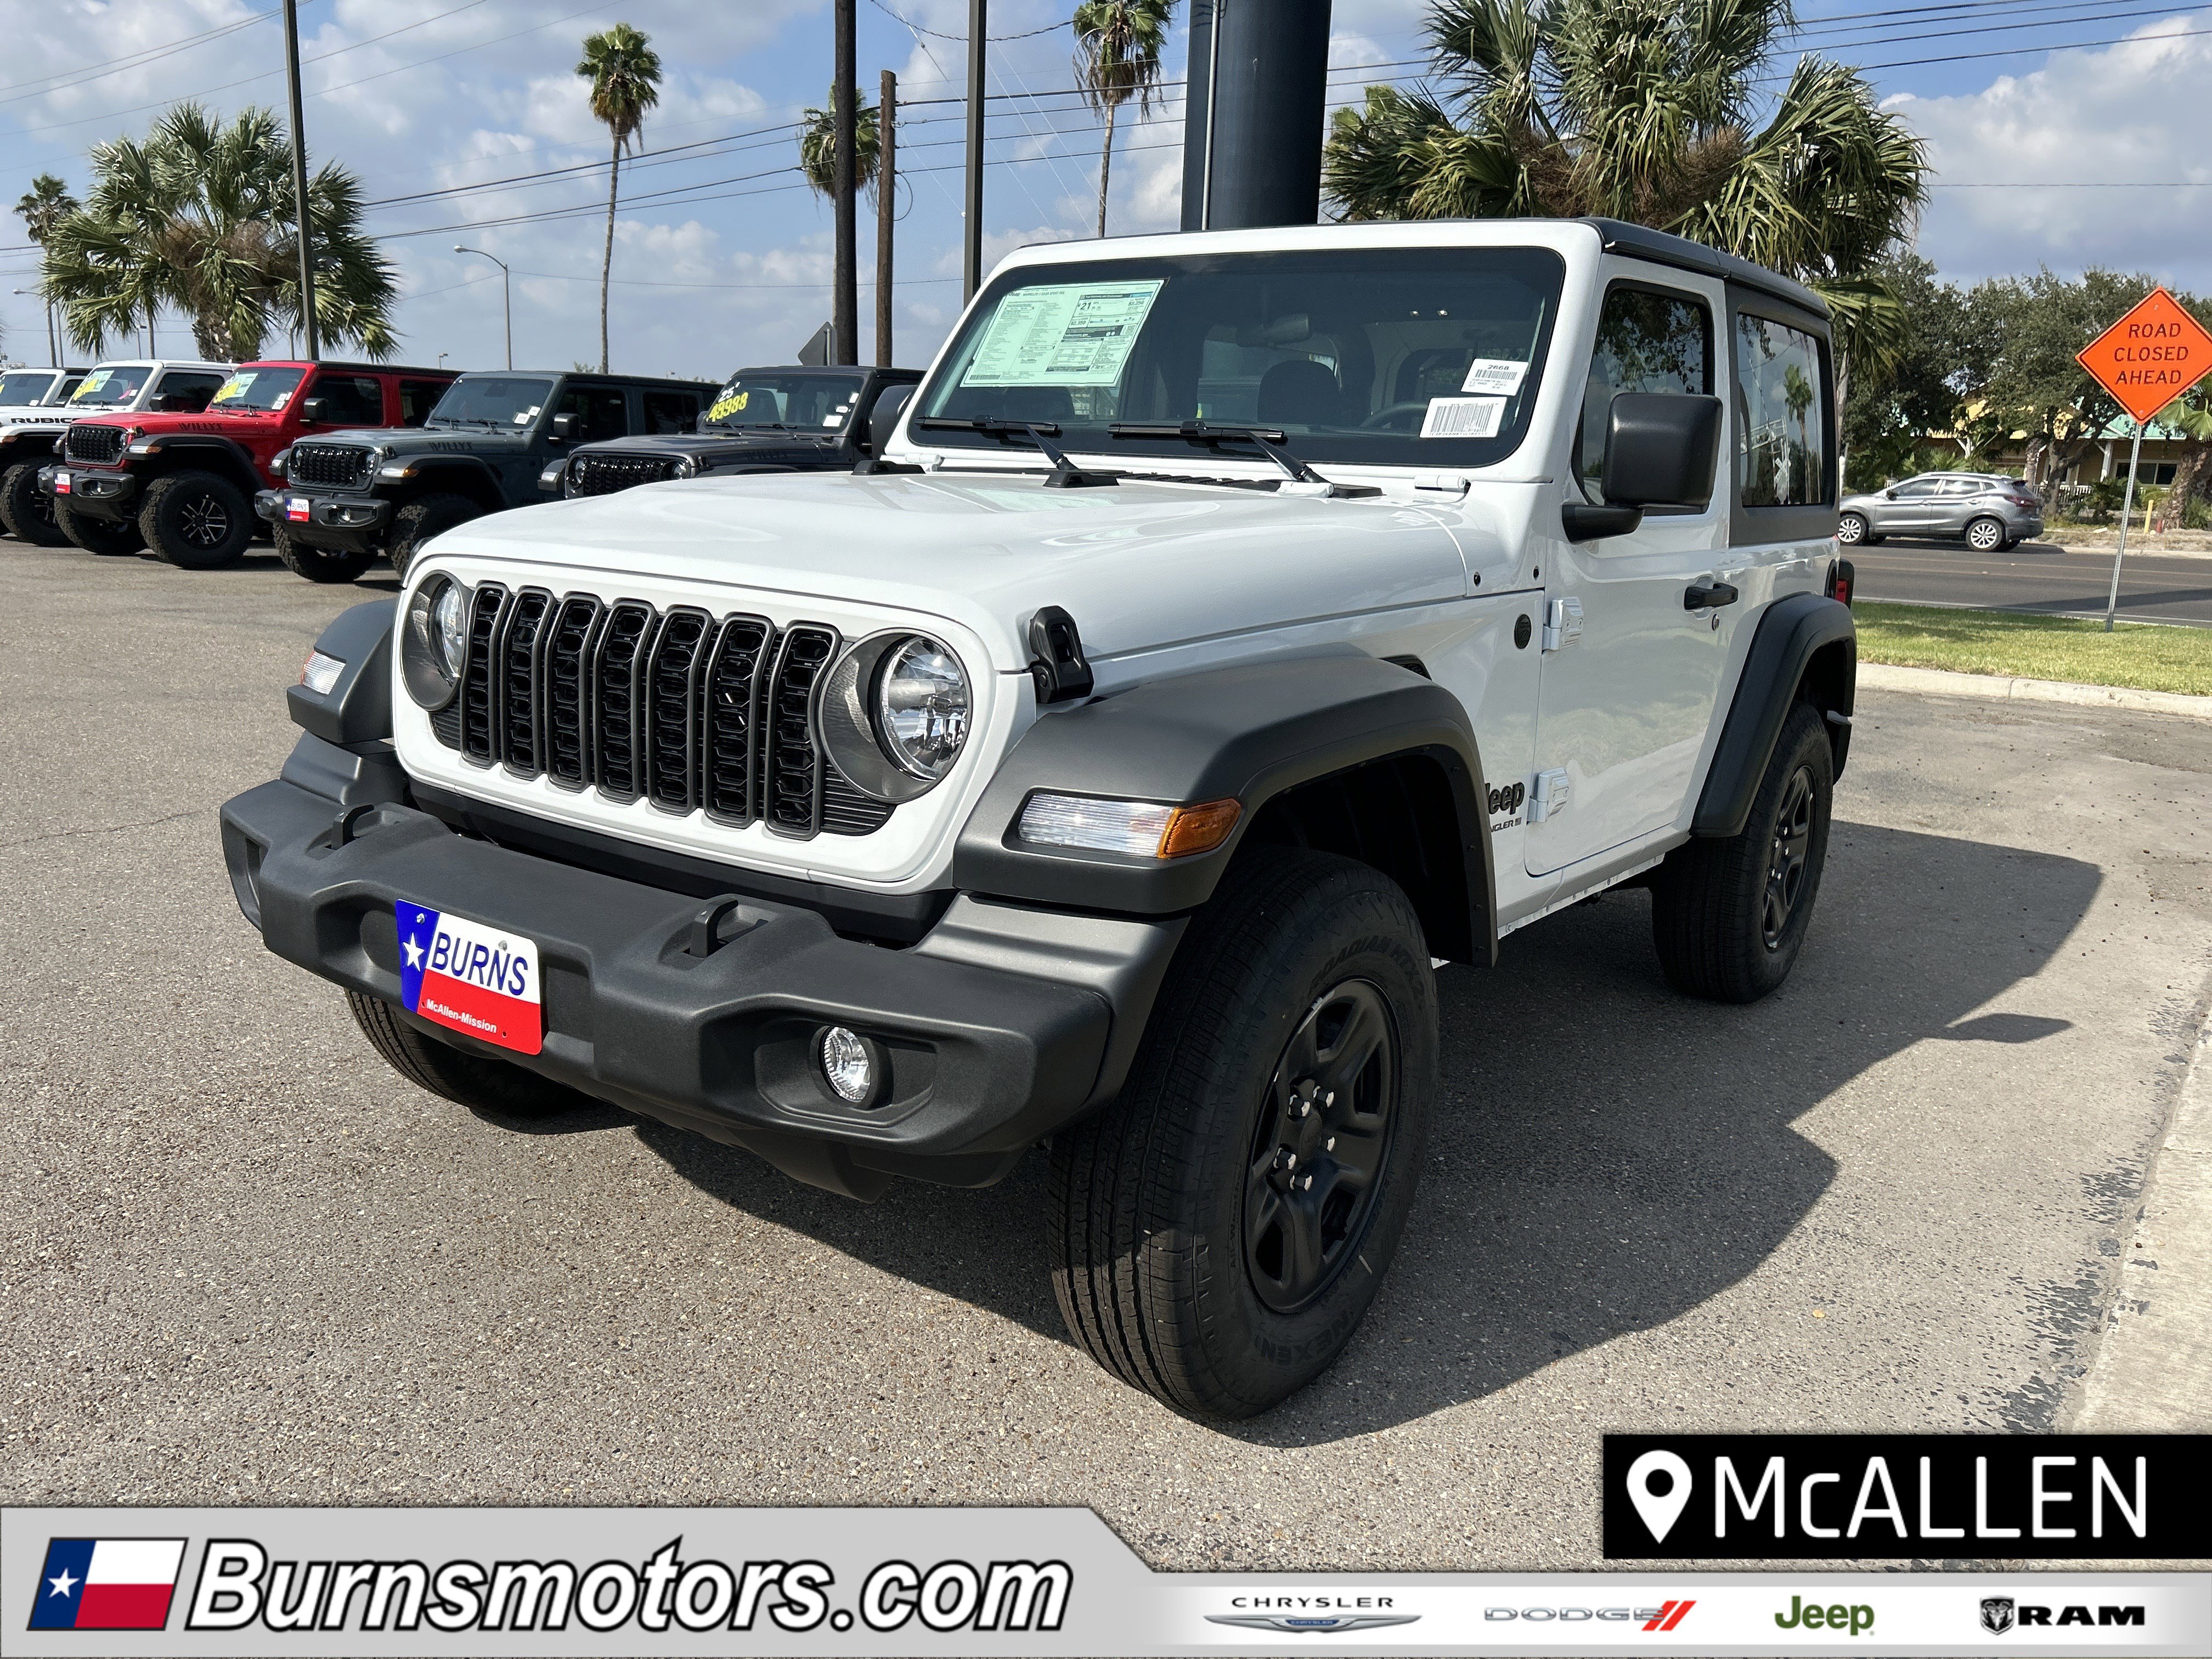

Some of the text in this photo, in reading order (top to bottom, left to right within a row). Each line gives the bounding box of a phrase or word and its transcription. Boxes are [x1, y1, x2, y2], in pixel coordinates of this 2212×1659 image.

[1080, 302, 1092, 311] 21
[2128, 323, 2181, 338] ROAD
[2114, 346, 2189, 362] CLOSED
[2115, 369, 2182, 385] AHEAD
[177, 422, 223, 431] WILLYS
[428, 442, 473, 452] WILLYS
[431, 932, 528, 996] BURNS
[426, 998, 497, 1034] McAllen-Mission
